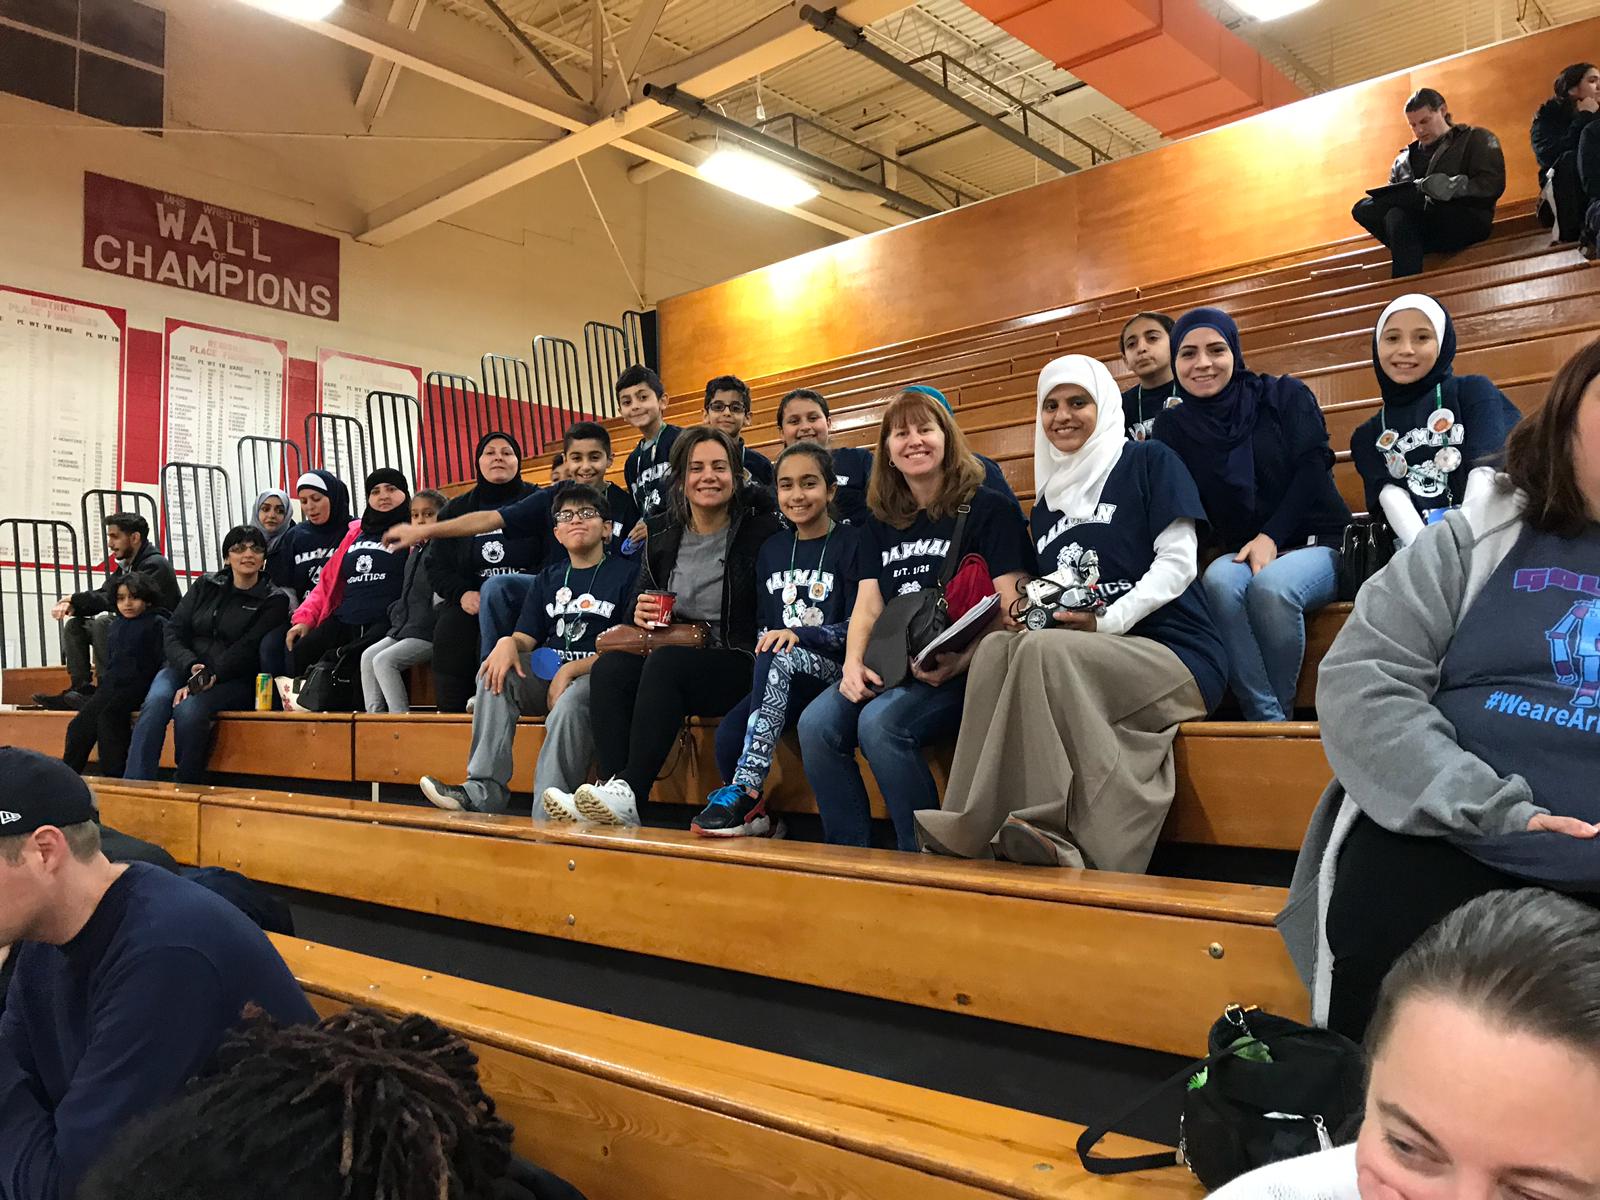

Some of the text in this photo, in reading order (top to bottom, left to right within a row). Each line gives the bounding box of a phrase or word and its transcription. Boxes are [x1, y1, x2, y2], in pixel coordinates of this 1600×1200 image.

[203, 203, 260, 227] WRESTLING
[156, 201, 272, 263] WALL
[212, 250, 227, 262] OF
[93, 234, 332, 316] CHAMPIONS
[29, 320, 40, 328] WT
[55, 326, 73, 335] NAME
[97, 333, 108, 341] WT
[189, 344, 217, 357] PLACE
[881, 537, 952, 568] OAKMA
[1484, 690, 1600, 735] #WeareAr
